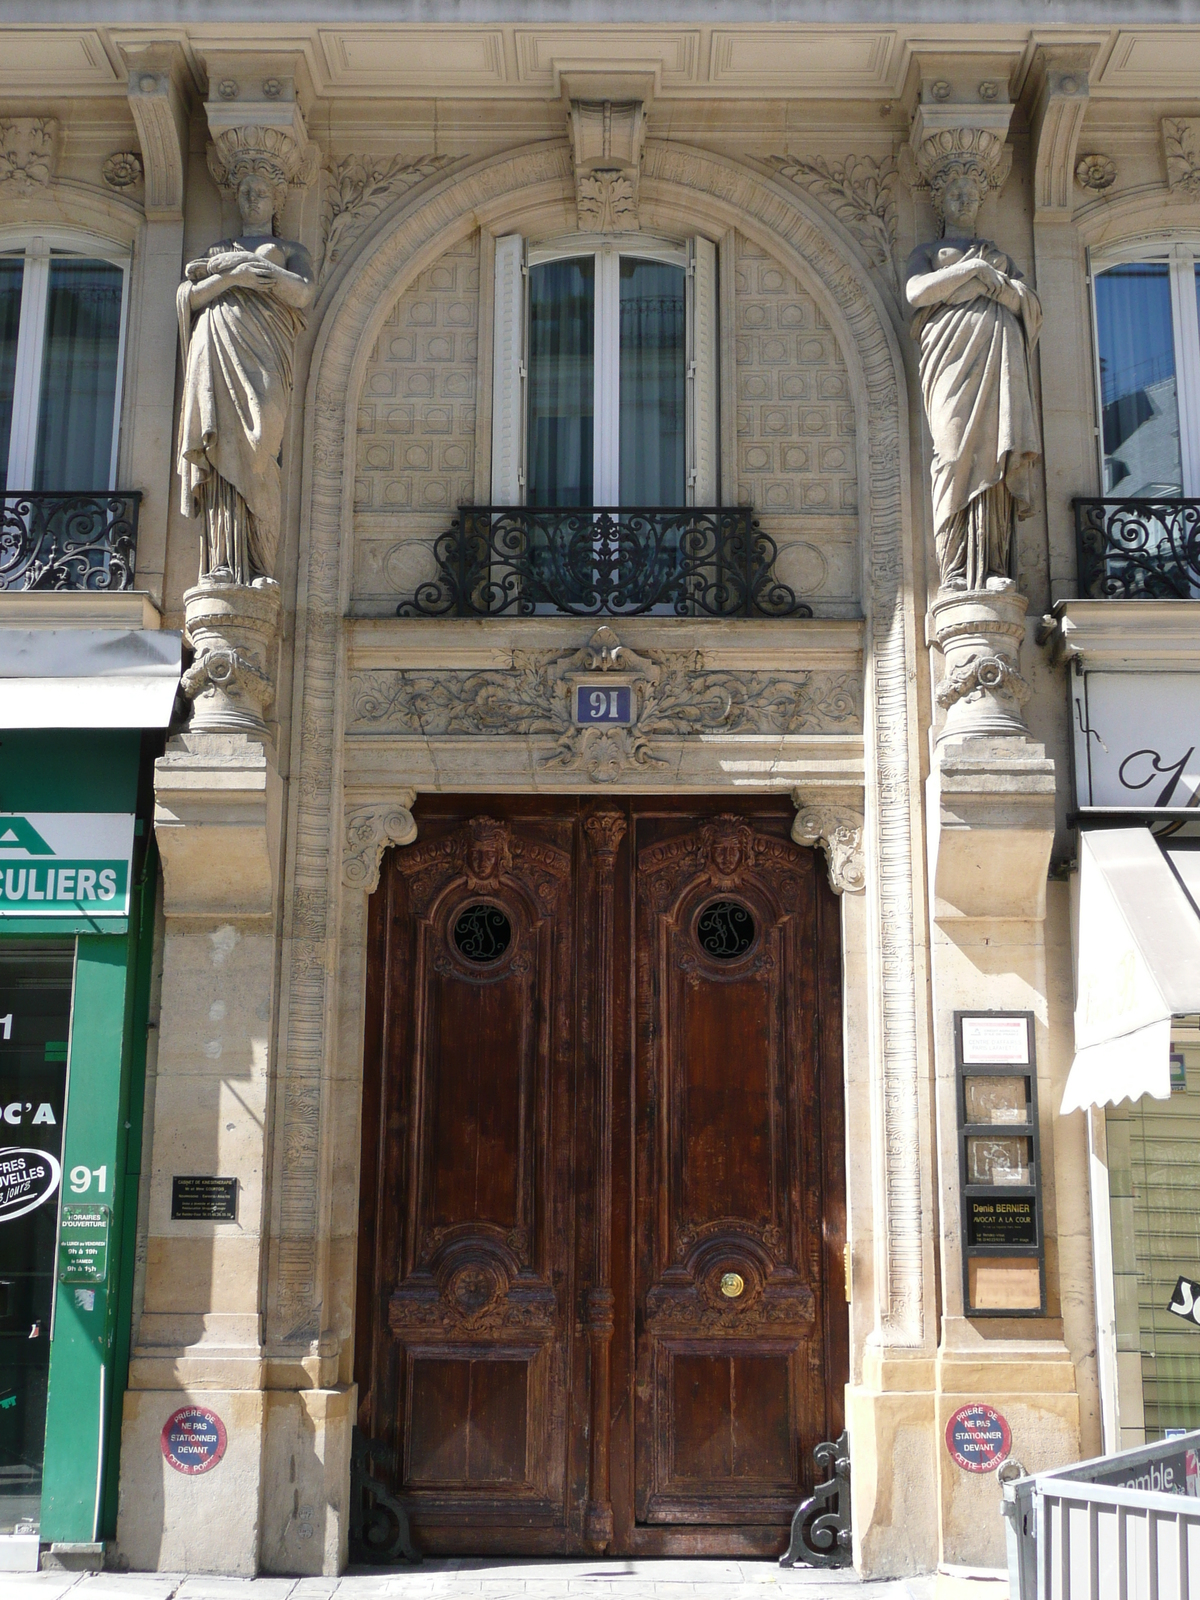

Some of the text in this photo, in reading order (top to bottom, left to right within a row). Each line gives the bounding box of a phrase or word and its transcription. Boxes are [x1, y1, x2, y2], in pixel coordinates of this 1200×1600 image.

[589, 691, 619, 718] 91
[0, 1102, 57, 1125] C'A
[69, 1165, 107, 1193] 91
[973, 1203, 1030, 1213] Denis BERNIER
[204, 1413, 216, 1424] DE
[987, 1410, 999, 1421] DE
[181, 1422, 207, 1430] NE PAS
[964, 1420, 991, 1428] NE PAS
[170, 1434, 217, 1442] STATIONNER
[955, 1431, 1002, 1440] STATIONNER
[177, 1446, 209, 1454] DEVANT
[963, 1443, 995, 1452] DEVANT
[169, 1453, 190, 1472] CETTE
[955, 1452, 978, 1470] CETTE
